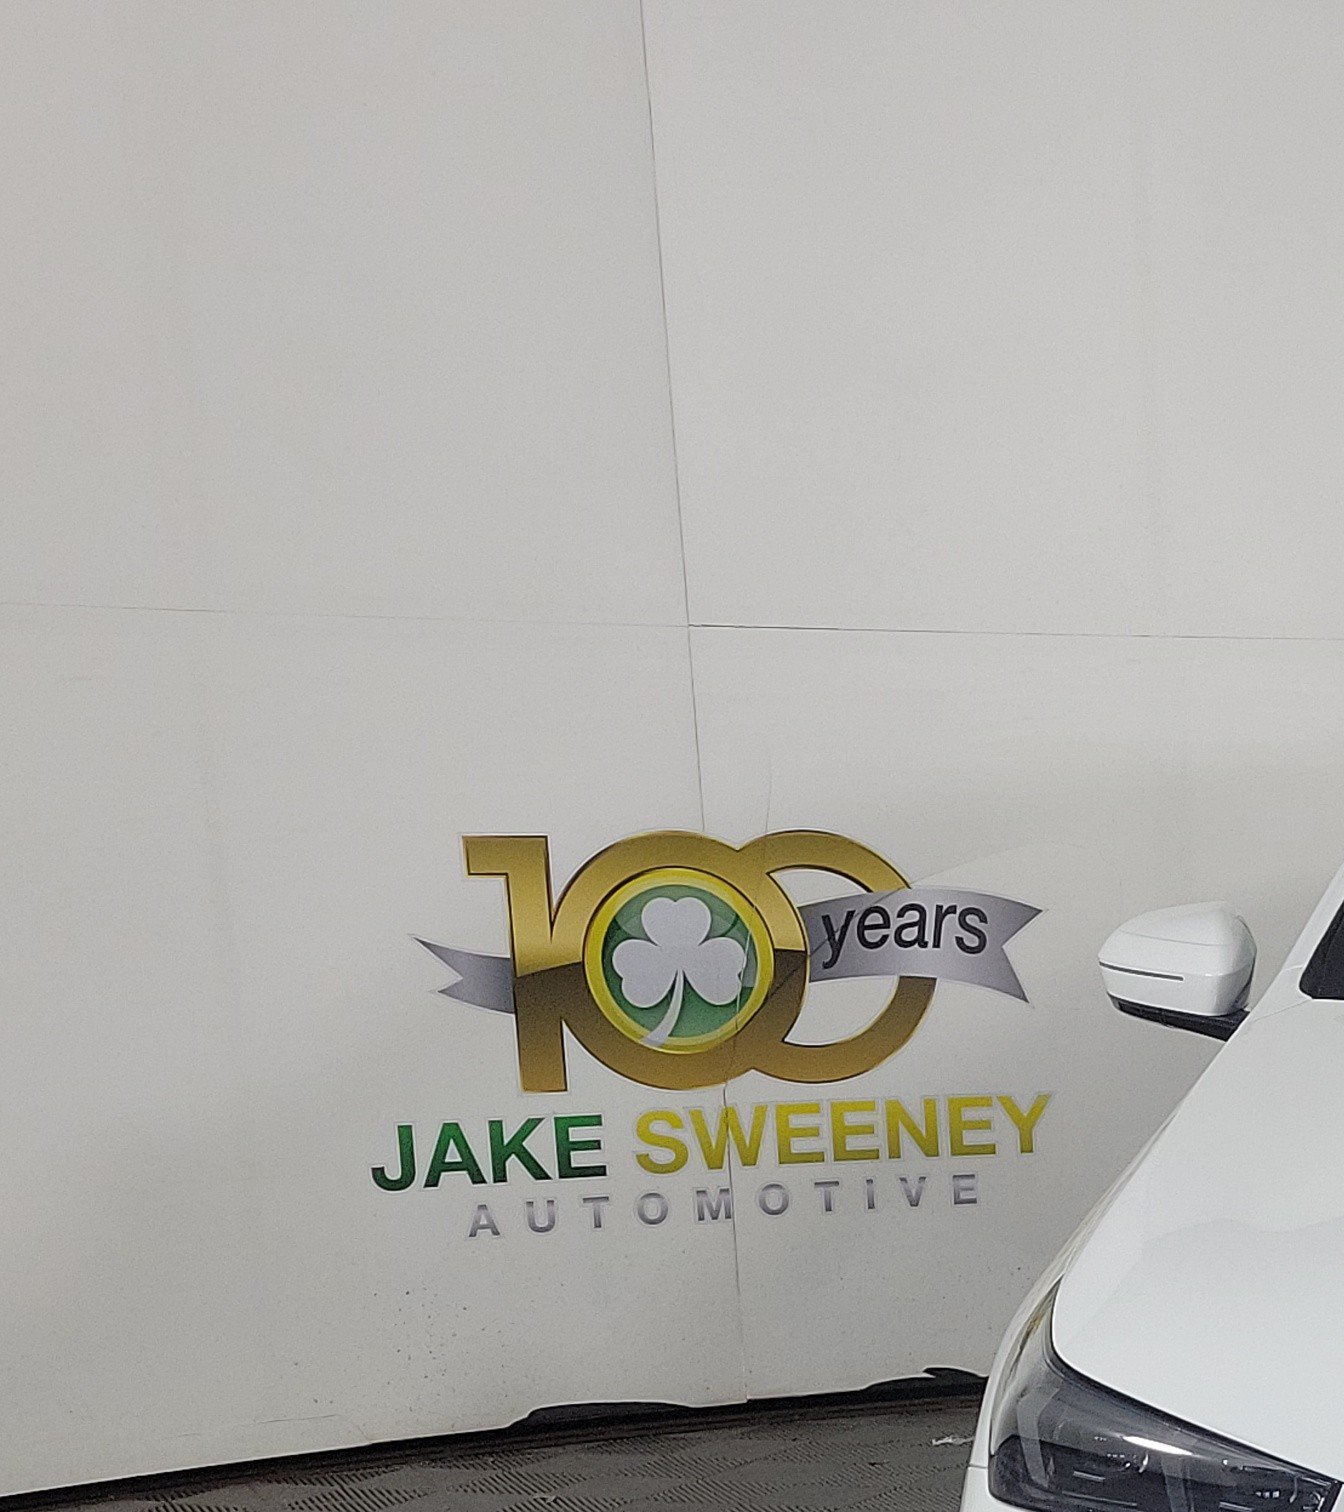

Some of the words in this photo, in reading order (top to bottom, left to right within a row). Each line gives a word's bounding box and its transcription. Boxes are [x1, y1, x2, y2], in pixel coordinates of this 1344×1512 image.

[462, 829, 937, 1091] 100
[821, 902, 989, 969] years
[371, 1113, 607, 1191] JAKE
[635, 1093, 1052, 1174] SWEENEY
[469, 1173, 978, 1238] AUTOMOTIVE
